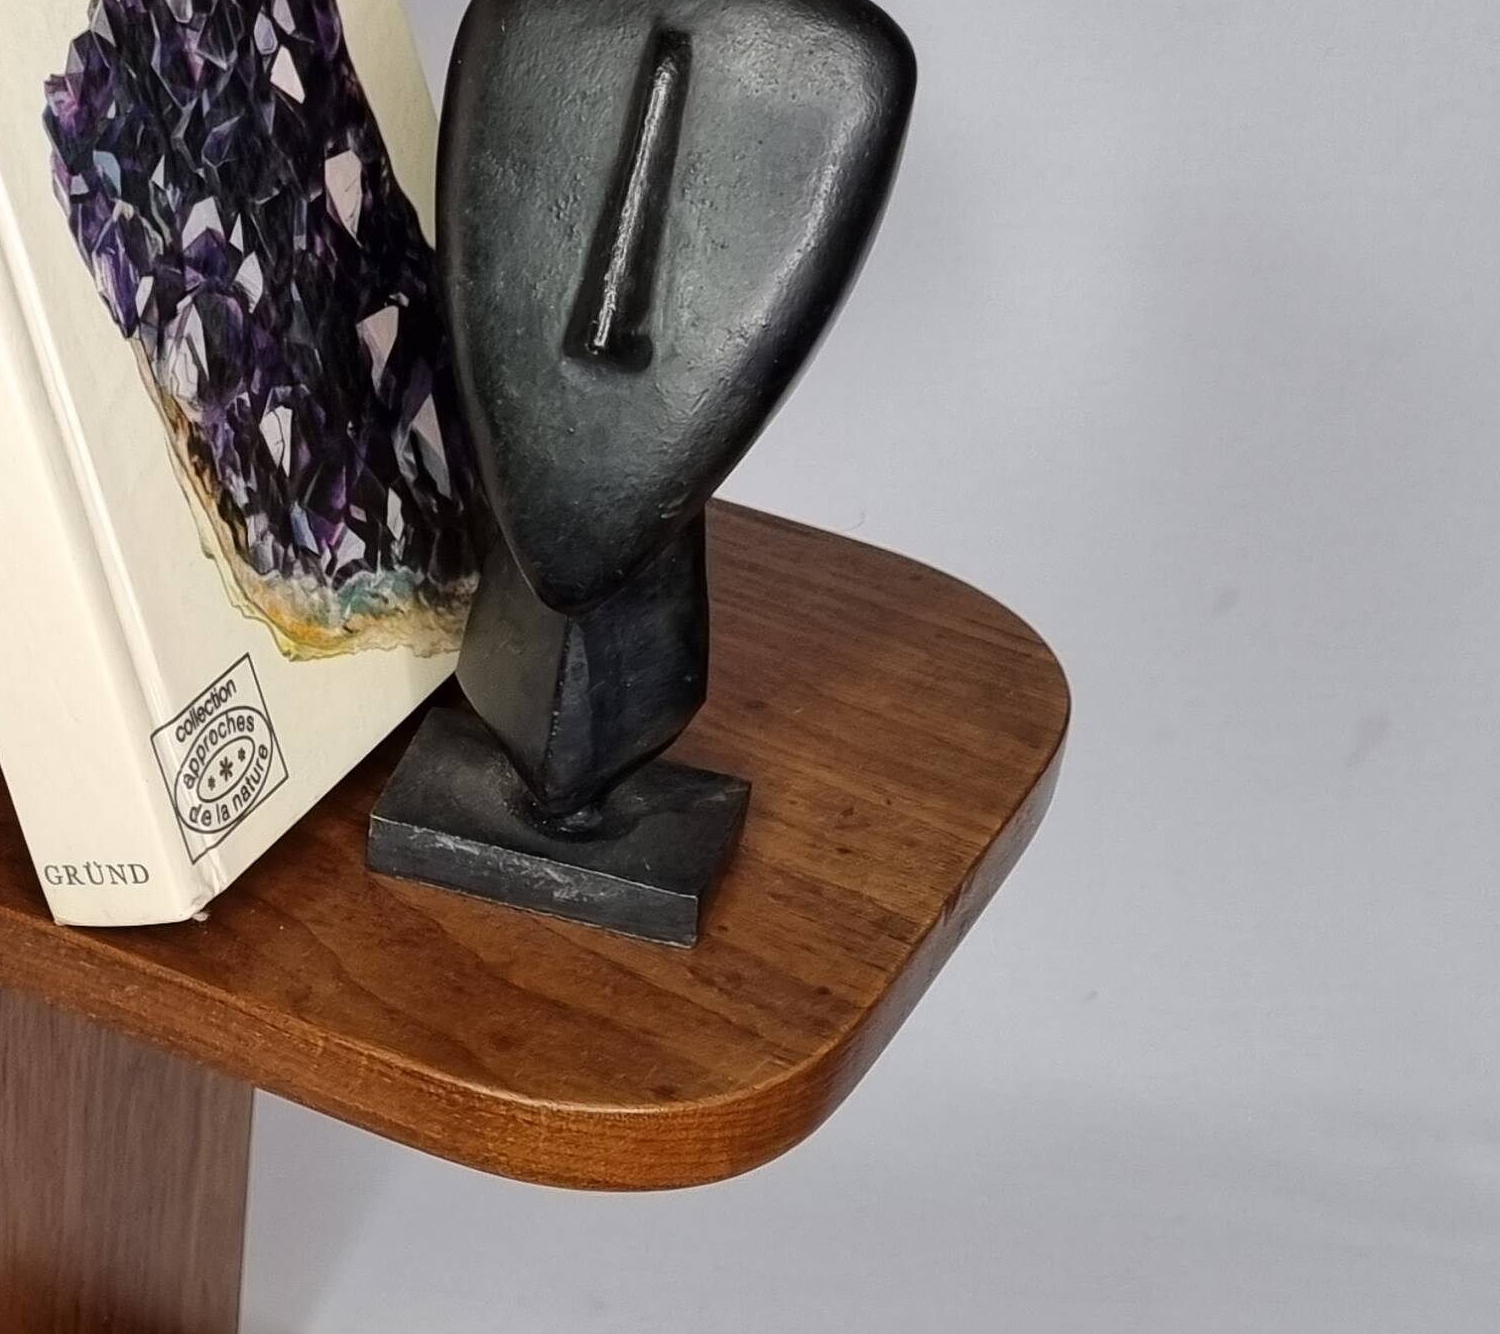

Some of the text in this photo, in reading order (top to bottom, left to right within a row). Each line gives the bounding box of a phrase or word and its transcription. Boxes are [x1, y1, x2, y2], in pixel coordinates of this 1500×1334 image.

[175, 678, 237, 743] collection
[182, 712, 255, 790] approches
[189, 743, 269, 827] de la nature
[44, 861, 150, 885] GRÜND
